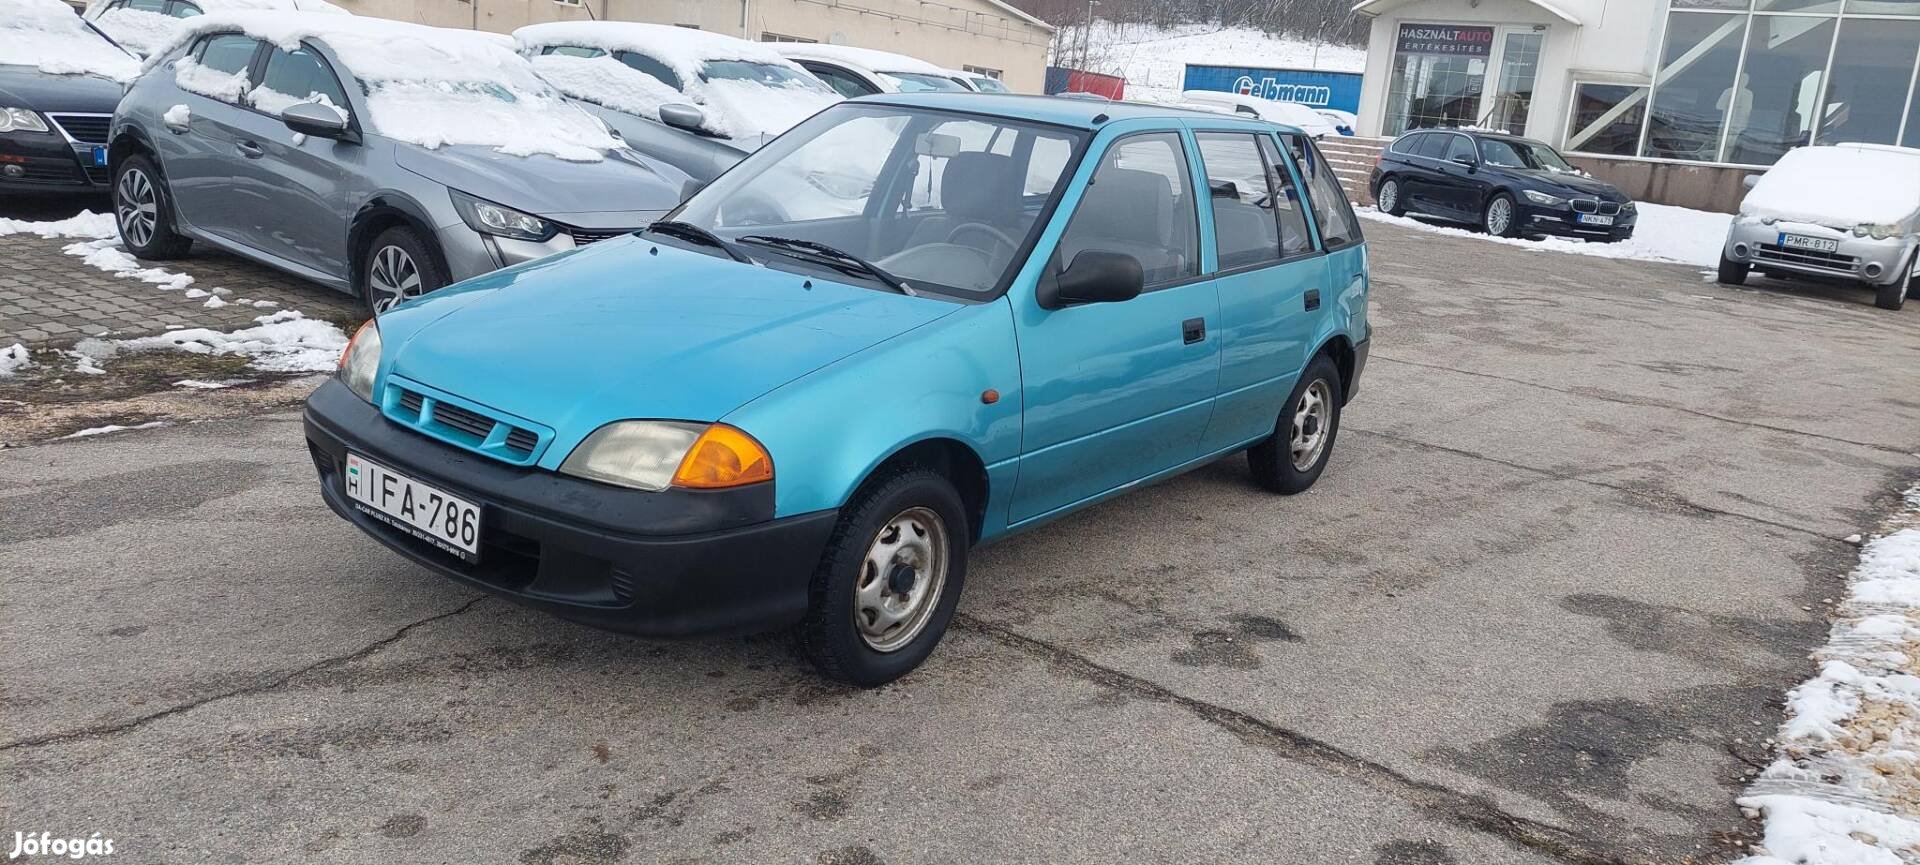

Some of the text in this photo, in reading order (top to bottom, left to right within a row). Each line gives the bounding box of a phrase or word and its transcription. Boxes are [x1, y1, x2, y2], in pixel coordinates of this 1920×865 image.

[1404, 42, 1482, 53] ÉRTÉKESÍTÉS
[1786, 235, 1834, 250] PMR-812
[349, 477, 357, 495] H
[370, 468, 476, 546] IFA-786
